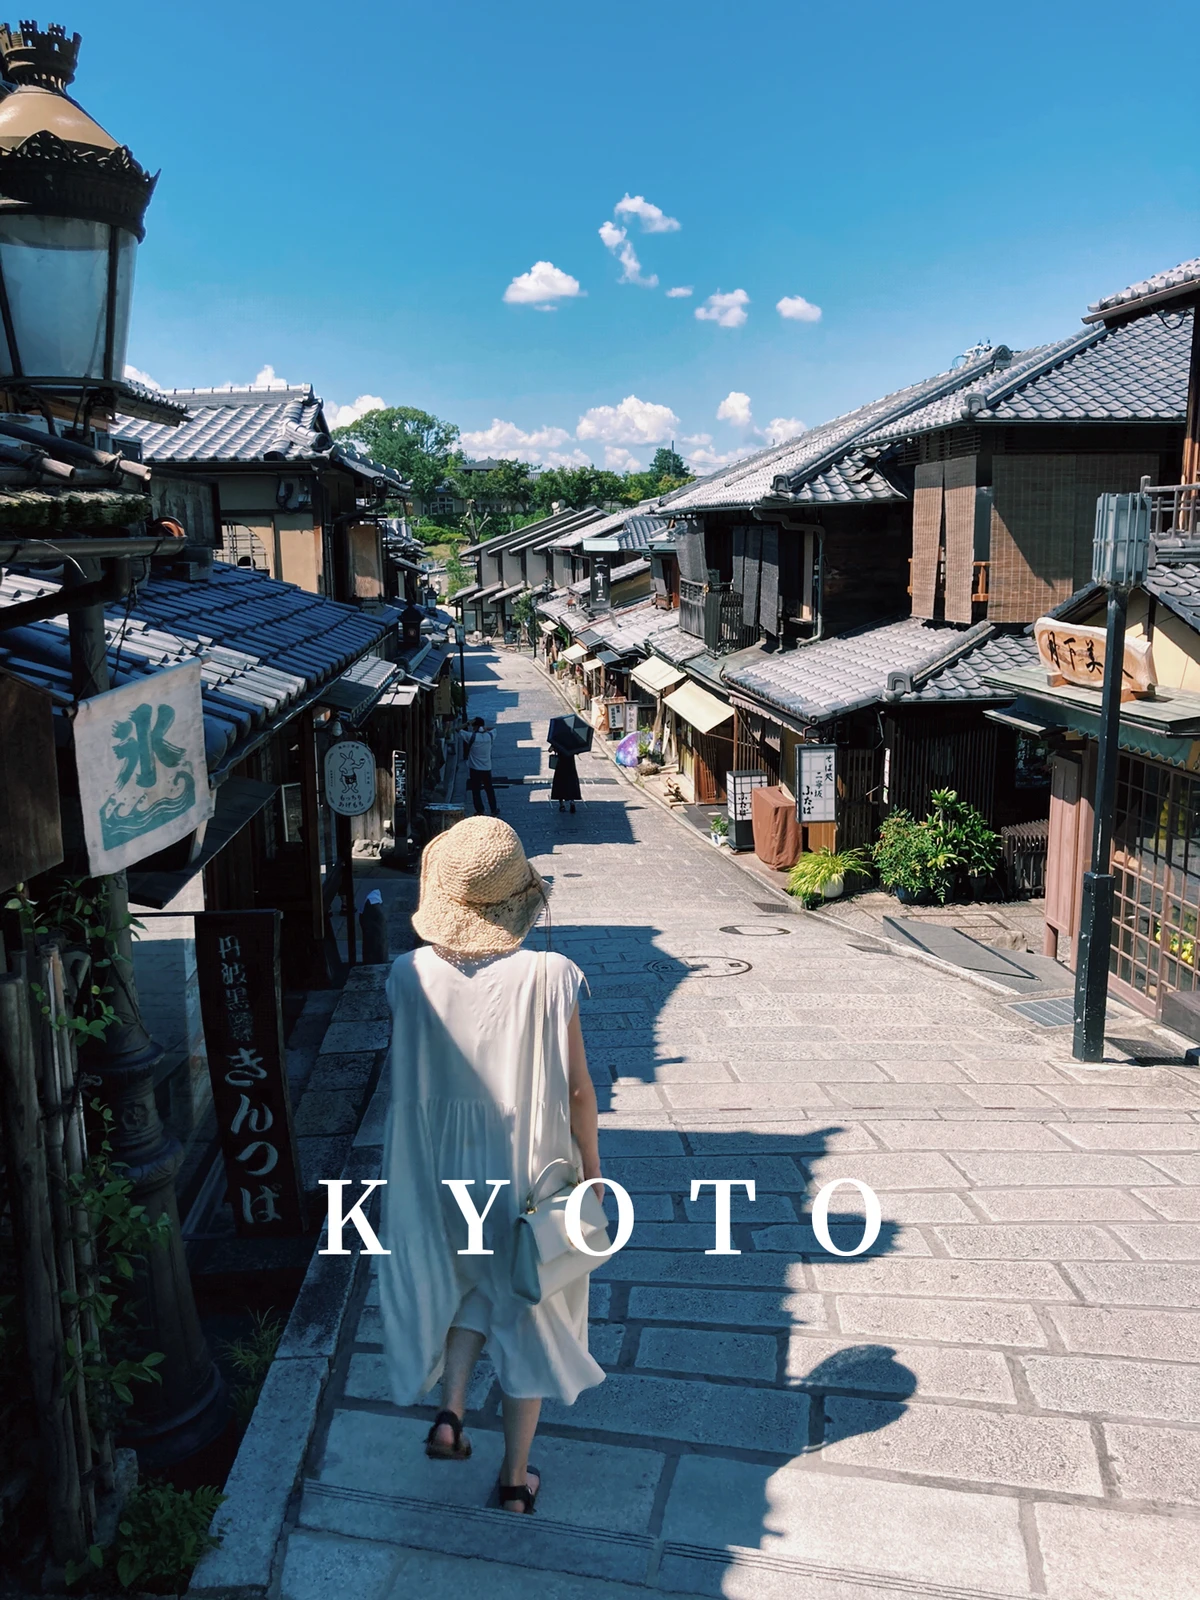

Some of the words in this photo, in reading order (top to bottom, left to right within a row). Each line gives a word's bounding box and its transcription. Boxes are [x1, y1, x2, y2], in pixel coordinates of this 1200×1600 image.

[1047, 630, 1135, 680] 月下美
[112, 702, 187, 789] 氷
[824, 754, 834, 782] そば処
[738, 791, 750, 816] ふたば
[802, 785, 815, 815] ふたば
[225, 1046, 283, 1225] きんつば
